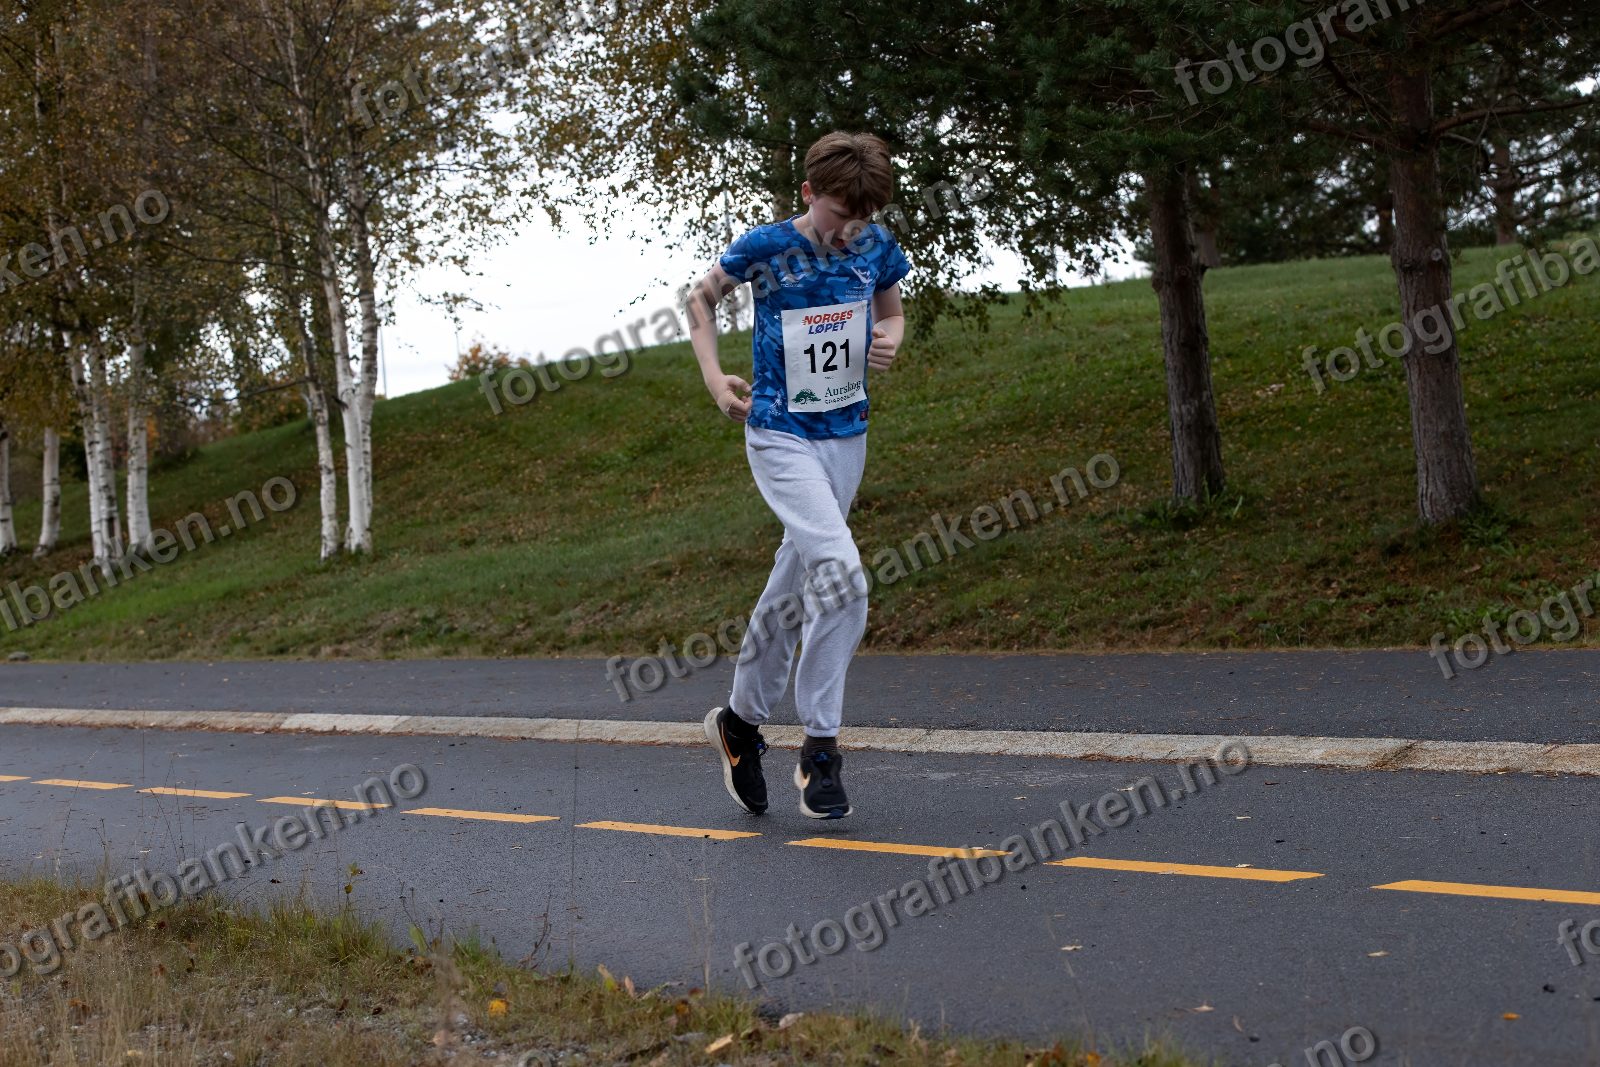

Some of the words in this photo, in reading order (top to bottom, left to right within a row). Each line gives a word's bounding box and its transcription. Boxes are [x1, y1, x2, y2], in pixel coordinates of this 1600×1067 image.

[802, 310, 853, 325] NORGES
[808, 321, 847, 335] LØPET
[803, 338, 850, 374] 121
